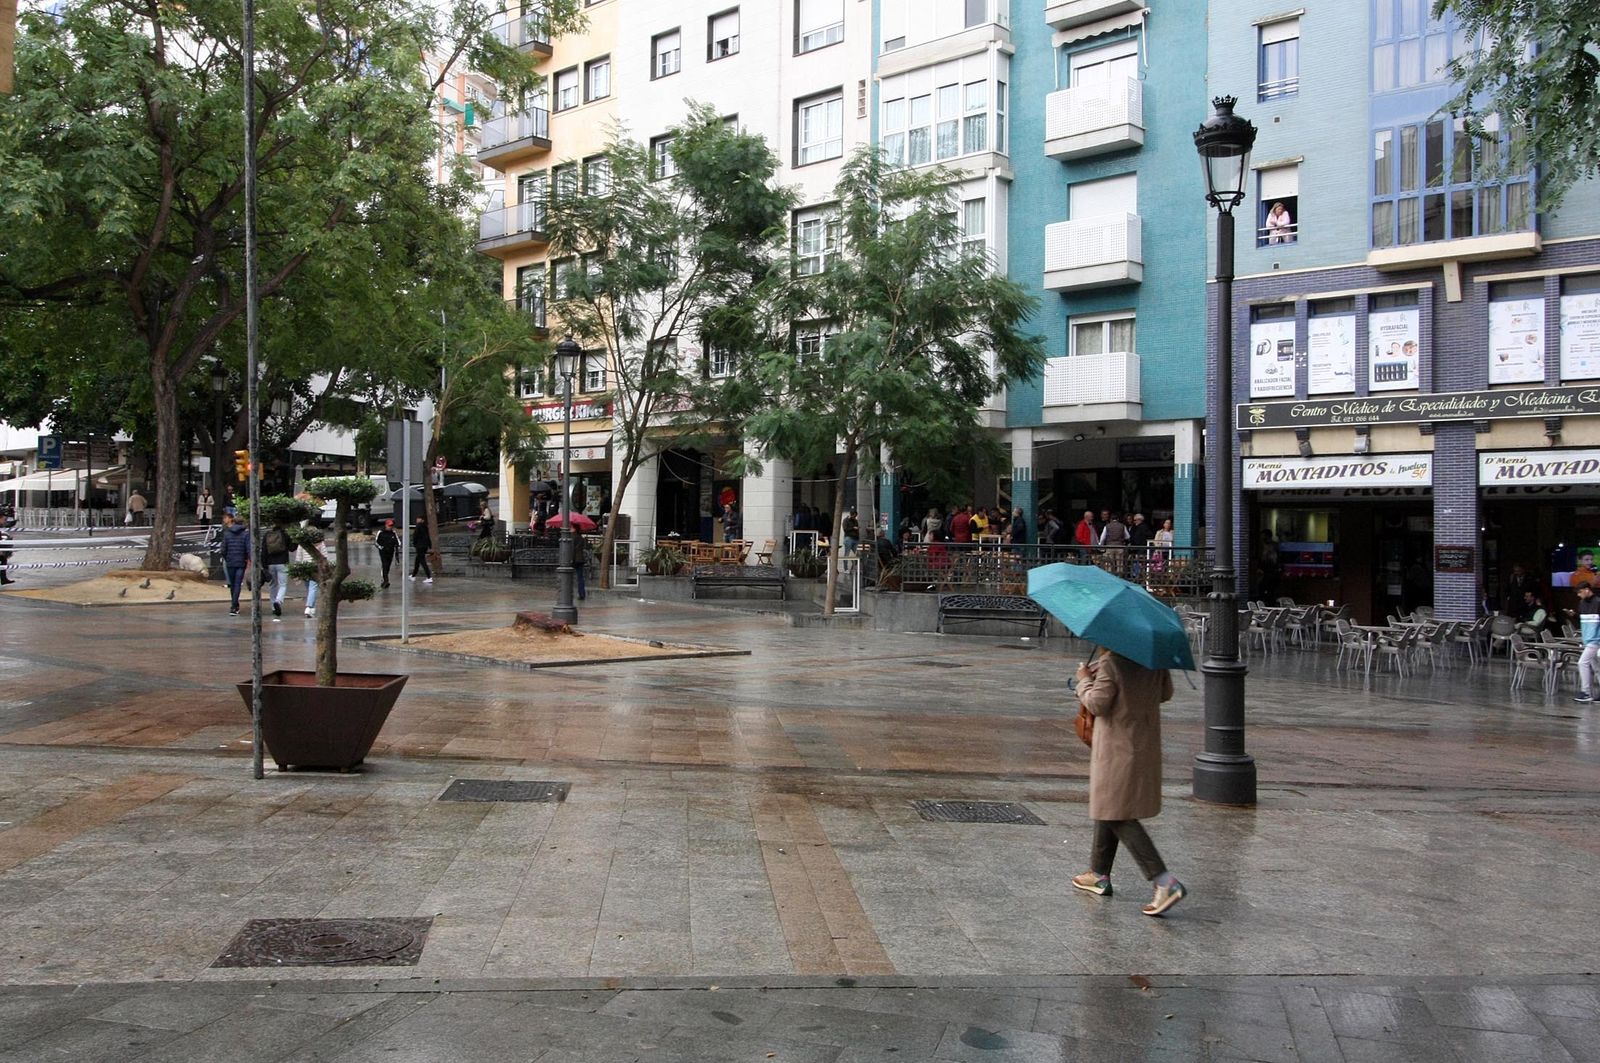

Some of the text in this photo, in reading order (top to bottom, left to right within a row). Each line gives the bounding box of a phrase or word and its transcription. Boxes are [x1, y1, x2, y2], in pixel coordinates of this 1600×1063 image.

[1290, 404, 1327, 417] Centro
[1331, 401, 1379, 416] Médico
[1381, 400, 1396, 412] de
[1398, 396, 1489, 415] Especialidades
[1488, 399, 1501, 412] y
[1504, 392, 1574, 407] Medicina
[43, 437, 57, 454] P
[1256, 461, 1388, 484] MONTADITOS
[1495, 458, 1600, 480] MONTAD
